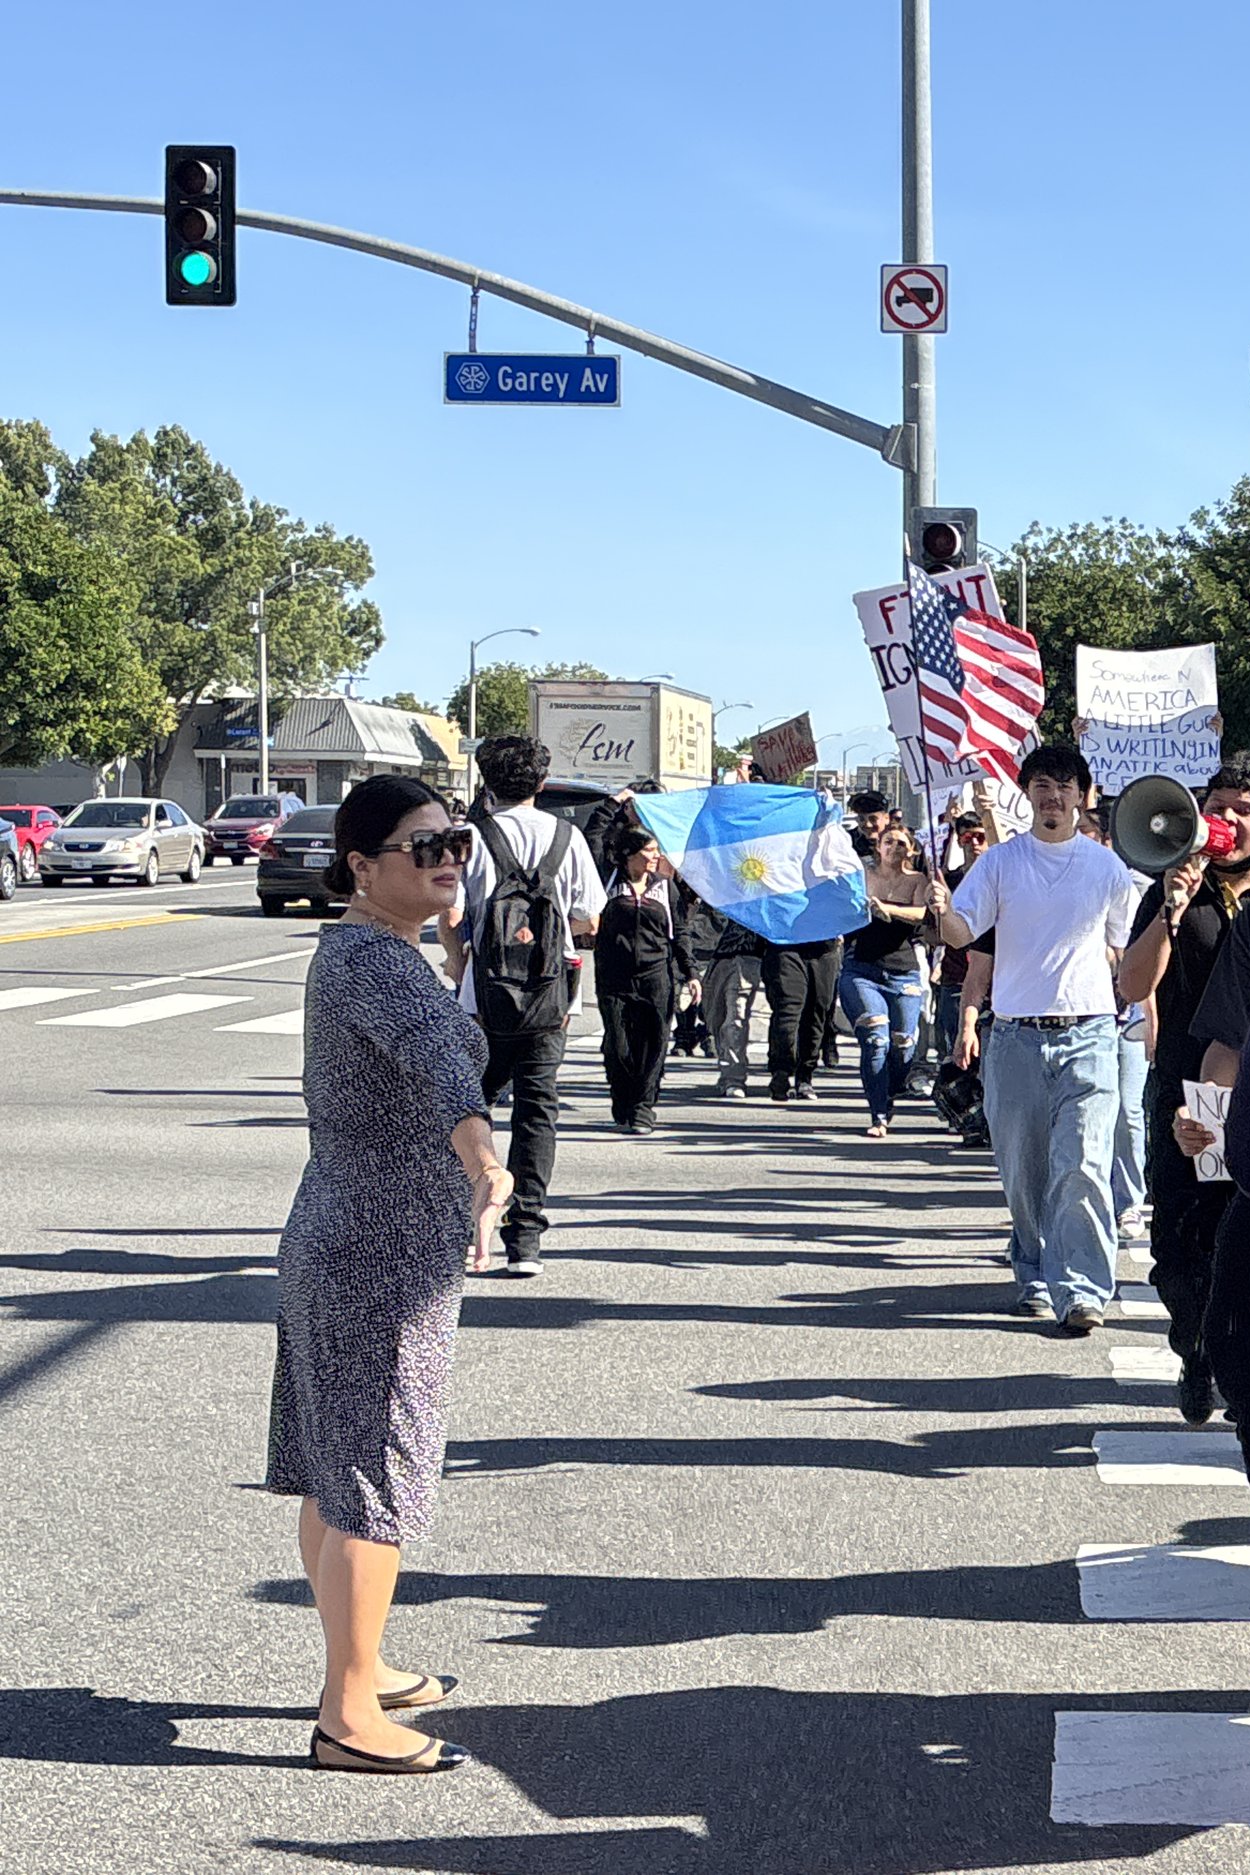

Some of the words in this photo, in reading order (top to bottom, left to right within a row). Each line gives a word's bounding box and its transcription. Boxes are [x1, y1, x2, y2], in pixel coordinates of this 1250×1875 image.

[498, 365, 569, 398] Garey
[580, 367, 608, 393] Av
[1091, 686, 1198, 712] AMERICA
[1104, 712, 1175, 734] LITTLE
